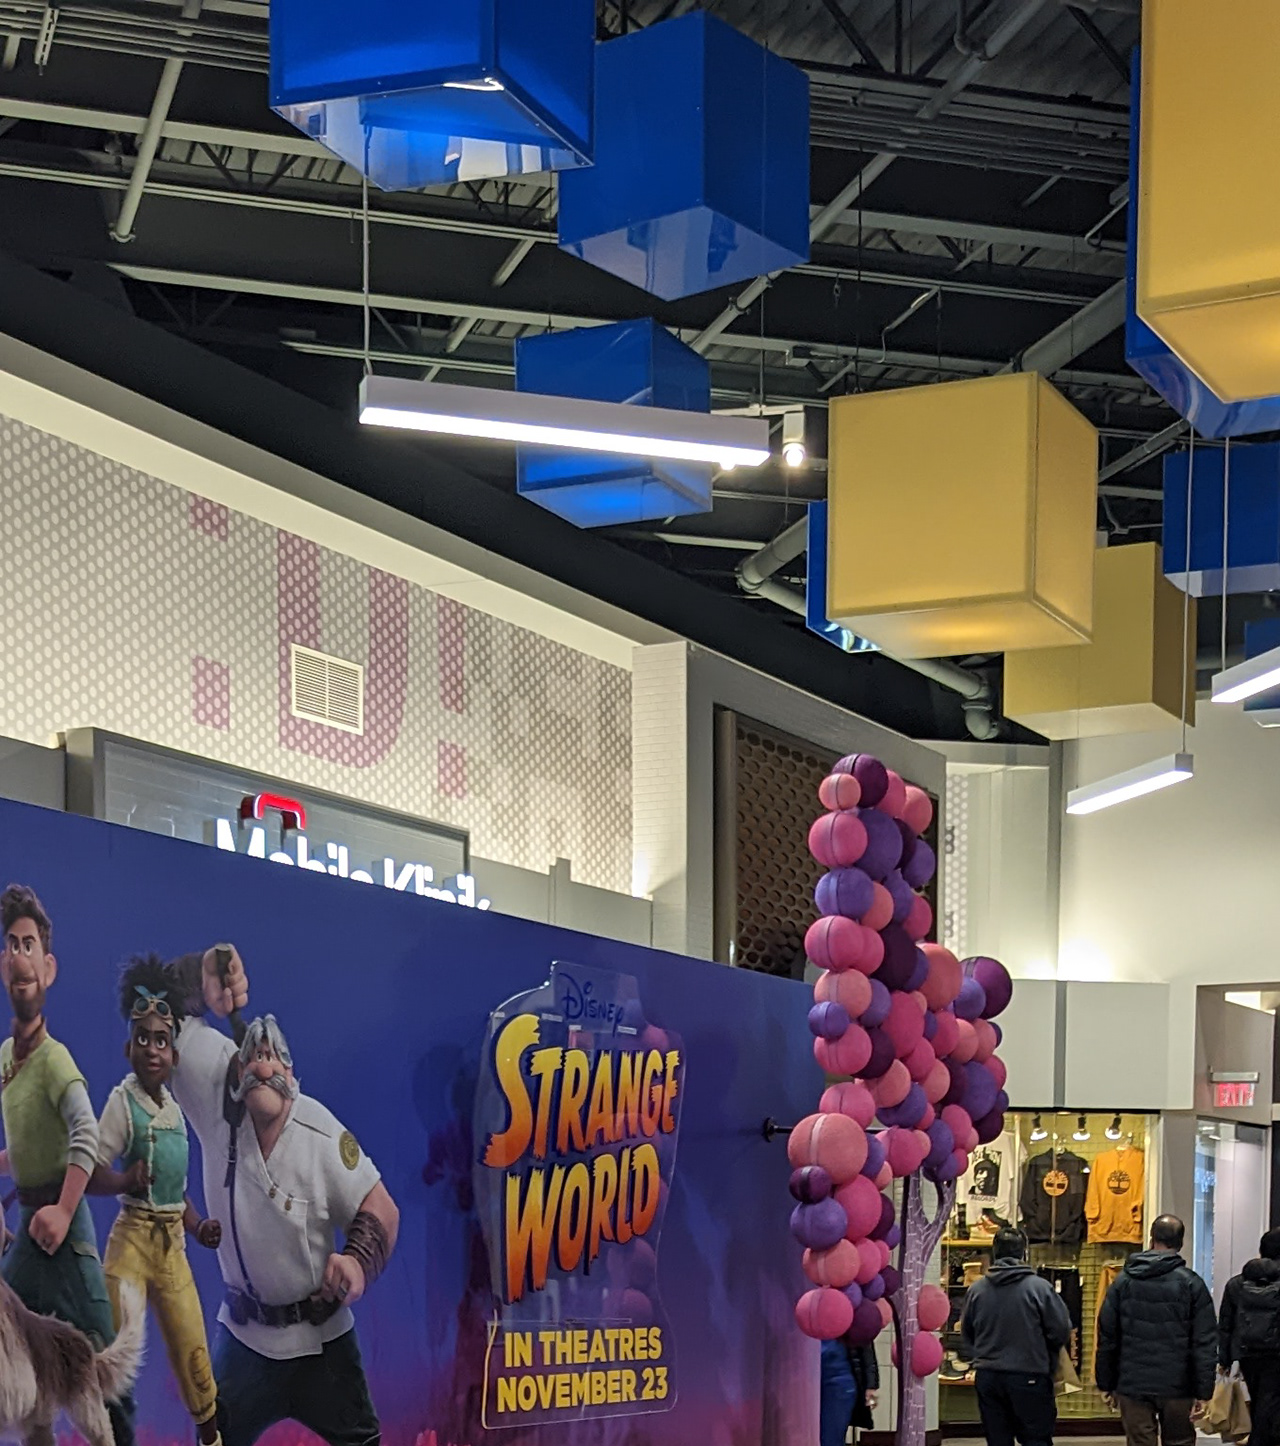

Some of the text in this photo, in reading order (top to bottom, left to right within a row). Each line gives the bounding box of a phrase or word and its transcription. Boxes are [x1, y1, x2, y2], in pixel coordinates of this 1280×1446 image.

[482, 1013, 681, 1169] STRANGE
[503, 1143, 661, 1304] WORLD
[497, 1366, 669, 1413] NOVEMBER 23
[504, 1326, 662, 1368] IN THEATRES
